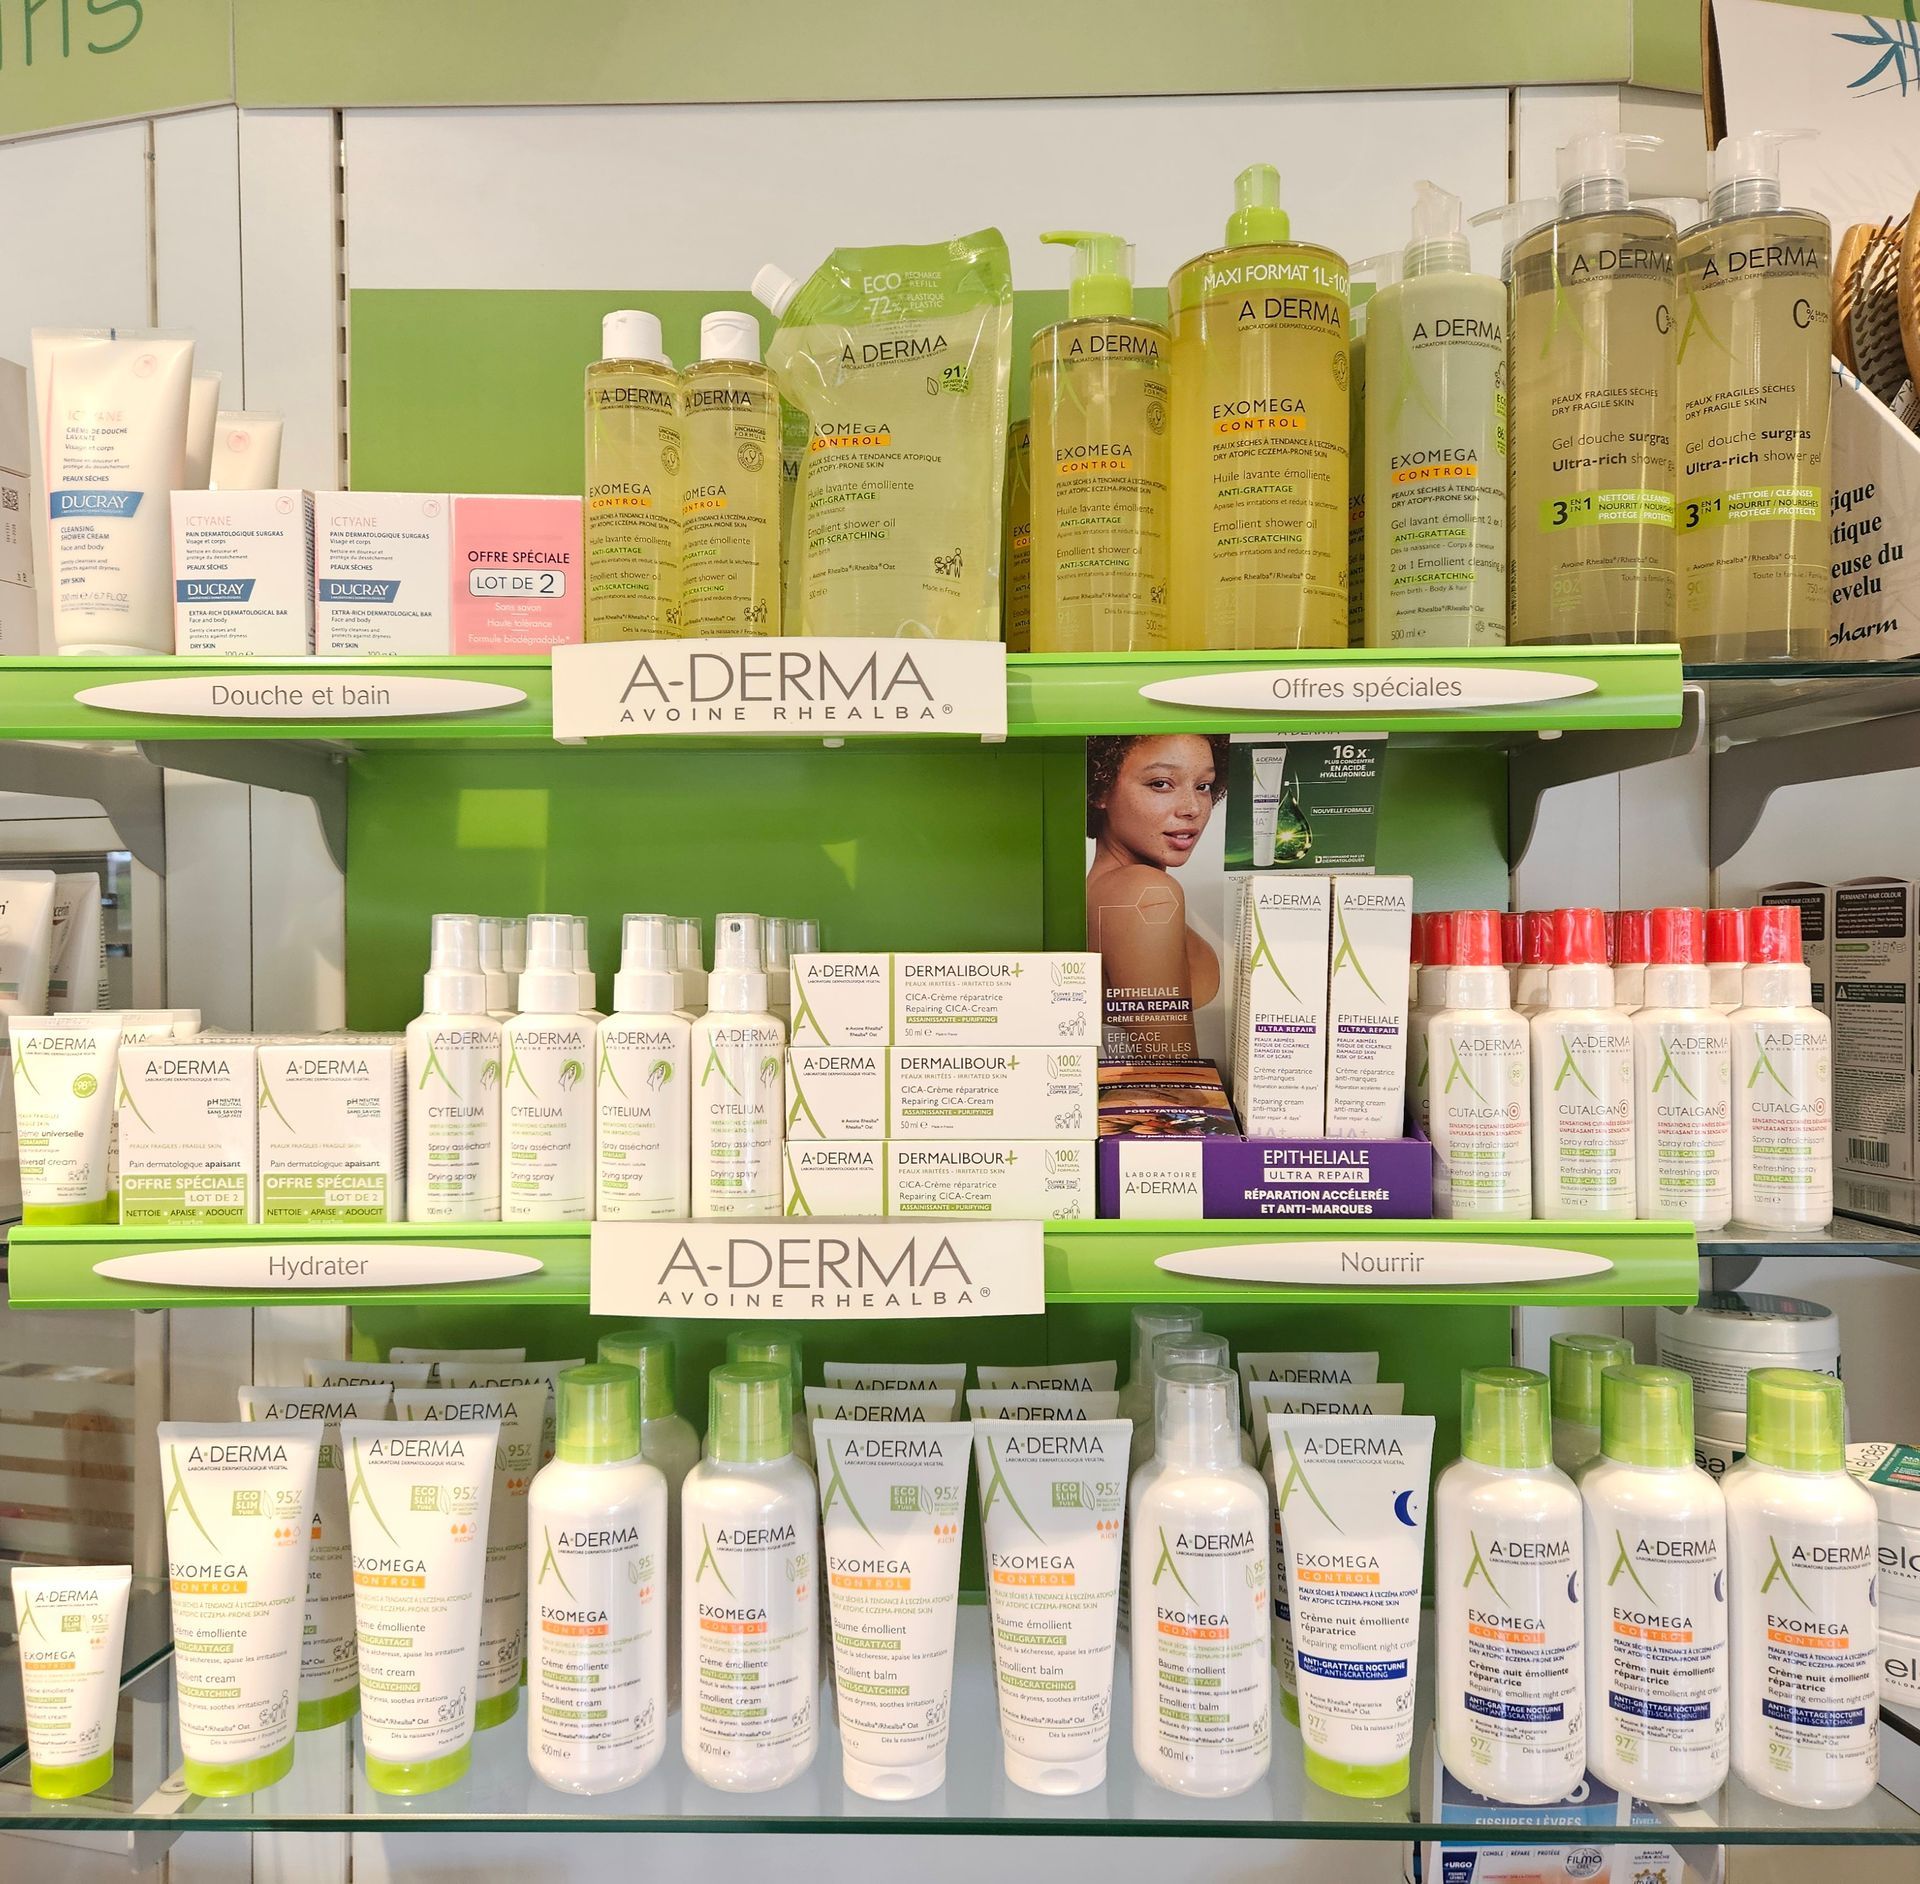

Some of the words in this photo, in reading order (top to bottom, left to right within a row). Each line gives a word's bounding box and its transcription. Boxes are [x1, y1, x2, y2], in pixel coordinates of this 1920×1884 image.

[863, 273, 901, 294] ECO
[1204, 269, 1241, 290] MAXI
[1245, 266, 1309, 284] FORMAT
[1686, 396, 1712, 410] PEAUX
[1715, 387, 1759, 400] FRAGILES
[1213, 400, 1305, 419] EXOMEGA
[1685, 409, 1700, 420] DRY
[1703, 400, 1741, 414] FRAGILE
[1744, 397, 1767, 405] SKIN
[1220, 418, 1299, 433] CONTROL
[811, 436, 882, 451] CONTROL
[1686, 442, 1704, 453] Gel
[1708, 432, 1756, 448] douche
[1761, 428, 1811, 441] surgras
[1056, 444, 1132, 461] EXOMEGA
[1391, 450, 1477, 470] EXOMEGA
[1062, 460, 1126, 472] CONTROL
[1552, 453, 1627, 472] Ultra-rich
[1686, 452, 1758, 475] Ultra-rich
[1764, 451, 1807, 462] shower
[1398, 467, 1472, 482] CONTROL
[589, 484, 651, 498] EXOMEGA
[1728, 490, 1768, 501] NETTOIE
[61, 495, 128, 509] DUCRAY
[186, 516, 232, 526] ICTYANE
[330, 516, 377, 526] ICTYANE
[1686, 504, 1699, 528] 3
[1213, 519, 1262, 533] Emollient
[1265, 518, 1302, 529] shower
[1306, 518, 1317, 530] oil
[1218, 534, 1302, 546] ANTI-SCRATCHING
[468, 551, 508, 563] OFFRE
[512, 549, 570, 563] SPÉCIALE
[1878, 542, 1903, 565] du
[188, 583, 244, 595] DUCRAY
[331, 583, 388, 596] DUCRAY
[476, 576, 507, 590] LOT
[511, 576, 534, 590] DE
[539, 573, 554, 594] 2
[620, 650, 934, 703] A-DERMA
[212, 684, 302, 706] Douche
[312, 687, 334, 706] et
[342, 684, 390, 706] bain
[1272, 678, 1344, 700] Offres
[1353, 675, 1462, 702] spéciales
[621, 707, 745, 722] AVOINE
[1333, 746, 1353, 759] 16
[1107, 987, 1179, 998] EPITHELIALE
[1107, 1001, 1144, 1012] ULTRA
[1147, 999, 1189, 1010] REPAIR
[1107, 1013, 1134, 1023] CRÈME
[1135, 1013, 1188, 1022] RÉPARATRICE
[1255, 1014, 1316, 1024] EPITHELIALE
[1108, 1032, 1160, 1042] EFFICACE
[1108, 1041, 1136, 1053] MÊME
[1139, 1043, 1159, 1052] SUR
[1163, 1043, 1191, 1052] LES
[428, 1107, 484, 1118] CYTELIUM
[710, 1104, 764, 1115] CYTELIUM
[1264, 1150, 1369, 1165] EPITHELIALE
[125, 1177, 177, 1190] OFFRE
[180, 1175, 244, 1190] SPÉCIALE
[1269, 1171, 1313, 1181] ULTRA
[1318, 1171, 1364, 1180] REPAIR
[190, 1193, 210, 1202] LOT
[214, 1193, 229, 1202] DE
[233, 1193, 239, 1202] 2
[1244, 1189, 1320, 1200] RÉPARATION
[1322, 1188, 1389, 1200] ACCÉLERÉE
[267, 1208, 301, 1216] NETTOIE
[311, 1208, 336, 1216] APAISE
[346, 1208, 383, 1216] ADOUCIT
[1261, 1204, 1275, 1214] ET
[1278, 1204, 1372, 1215] ANTI-MARQUES
[269, 1255, 368, 1280] Hydrater
[657, 1236, 972, 1289] A-DERMA
[1342, 1252, 1424, 1273] Nourrir
[658, 1291, 783, 1307] AVOINE
[830, 1558, 911, 1574] EXOMEGA
[992, 1553, 1075, 1570] EXOMEGA
[1297, 1553, 1379, 1569] EXOMEGA
[170, 1563, 249, 1579] EXOMEGA
[541, 1606, 608, 1622] EXOMEGA
[699, 1605, 767, 1621] EXOMEGA
[1157, 1607, 1229, 1625] EXOMEGA
[1469, 1609, 1545, 1631] EXOMEGA
[861, 1623, 906, 1635] émollient
[1767, 1615, 1849, 1635] EXOMEGA
[24, 1651, 76, 1661] EXOMEGA
